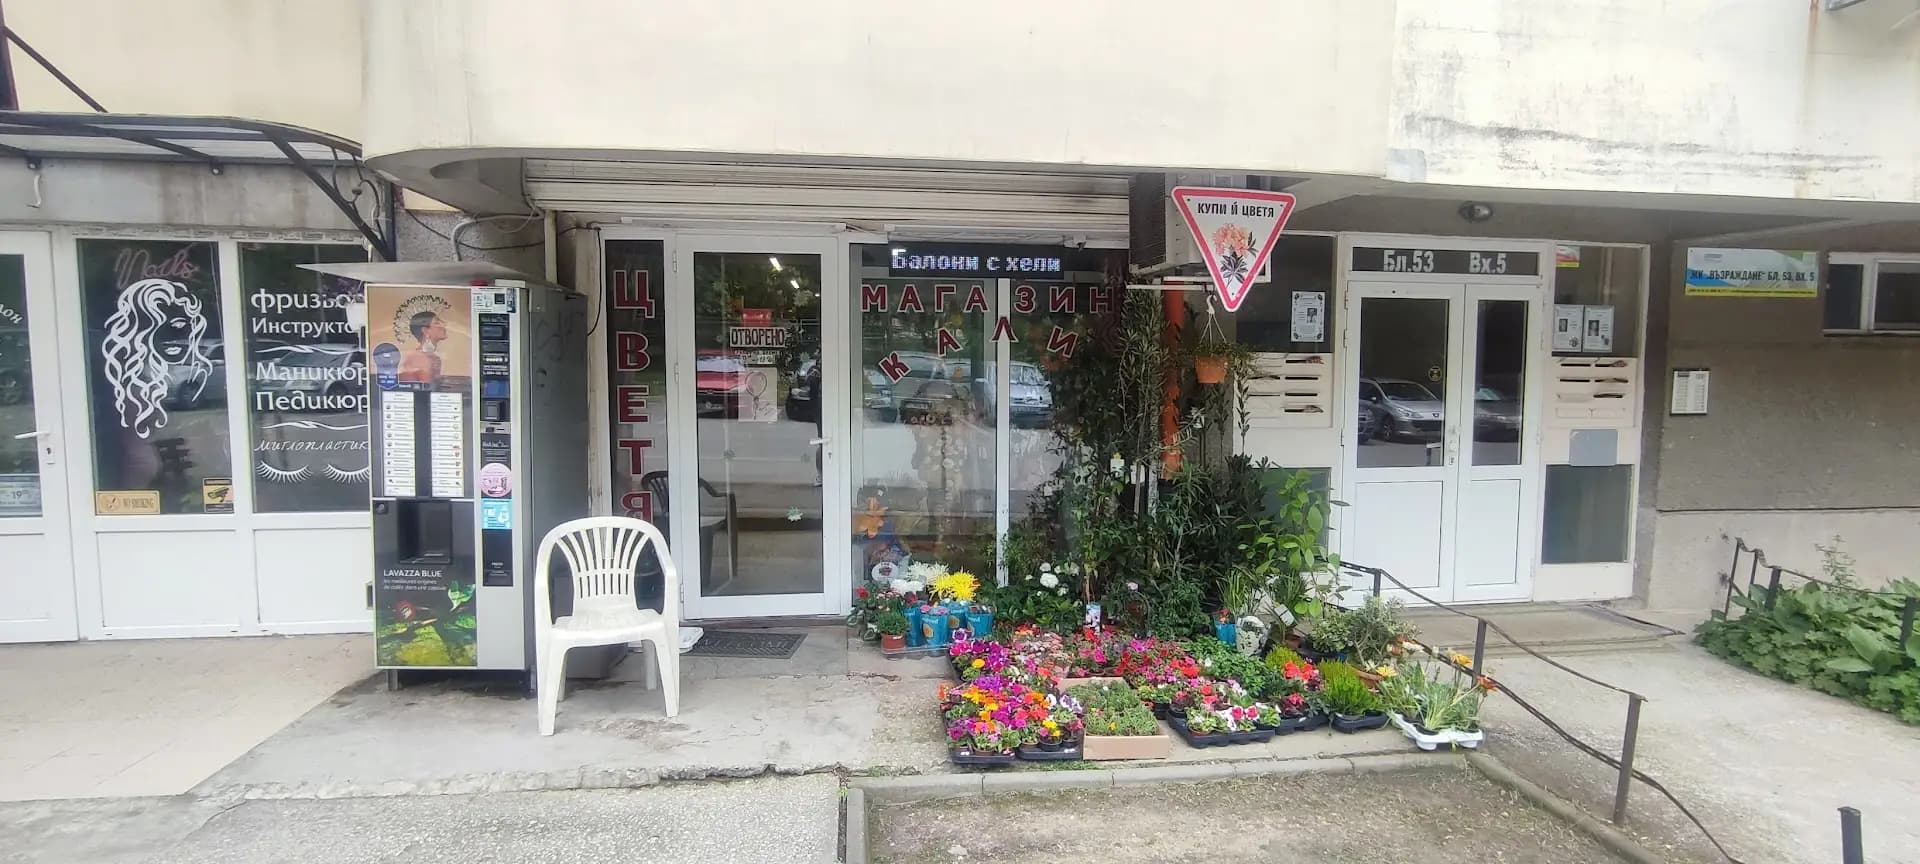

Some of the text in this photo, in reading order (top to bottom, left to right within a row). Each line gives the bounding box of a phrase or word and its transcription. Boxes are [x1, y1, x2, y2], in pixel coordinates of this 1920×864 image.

[1198, 203, 1227, 215] КУПИ
[1242, 205, 1274, 218] ЦВЕТЯ
[892, 248, 1061, 272] Балони с хели
[1383, 249, 1507, 274] Бл.53 Вх.5
[1809, 271, 1815, 281] 5
[860, 284, 1117, 313] МАГАЗИН
[731, 328, 785, 346] ОТВОРЕНО
[878, 316, 1079, 384] КАЛИ
[613, 269, 656, 524] ЦВЕТЯ
[383, 569, 443, 578] LAVAZZA BLUE
